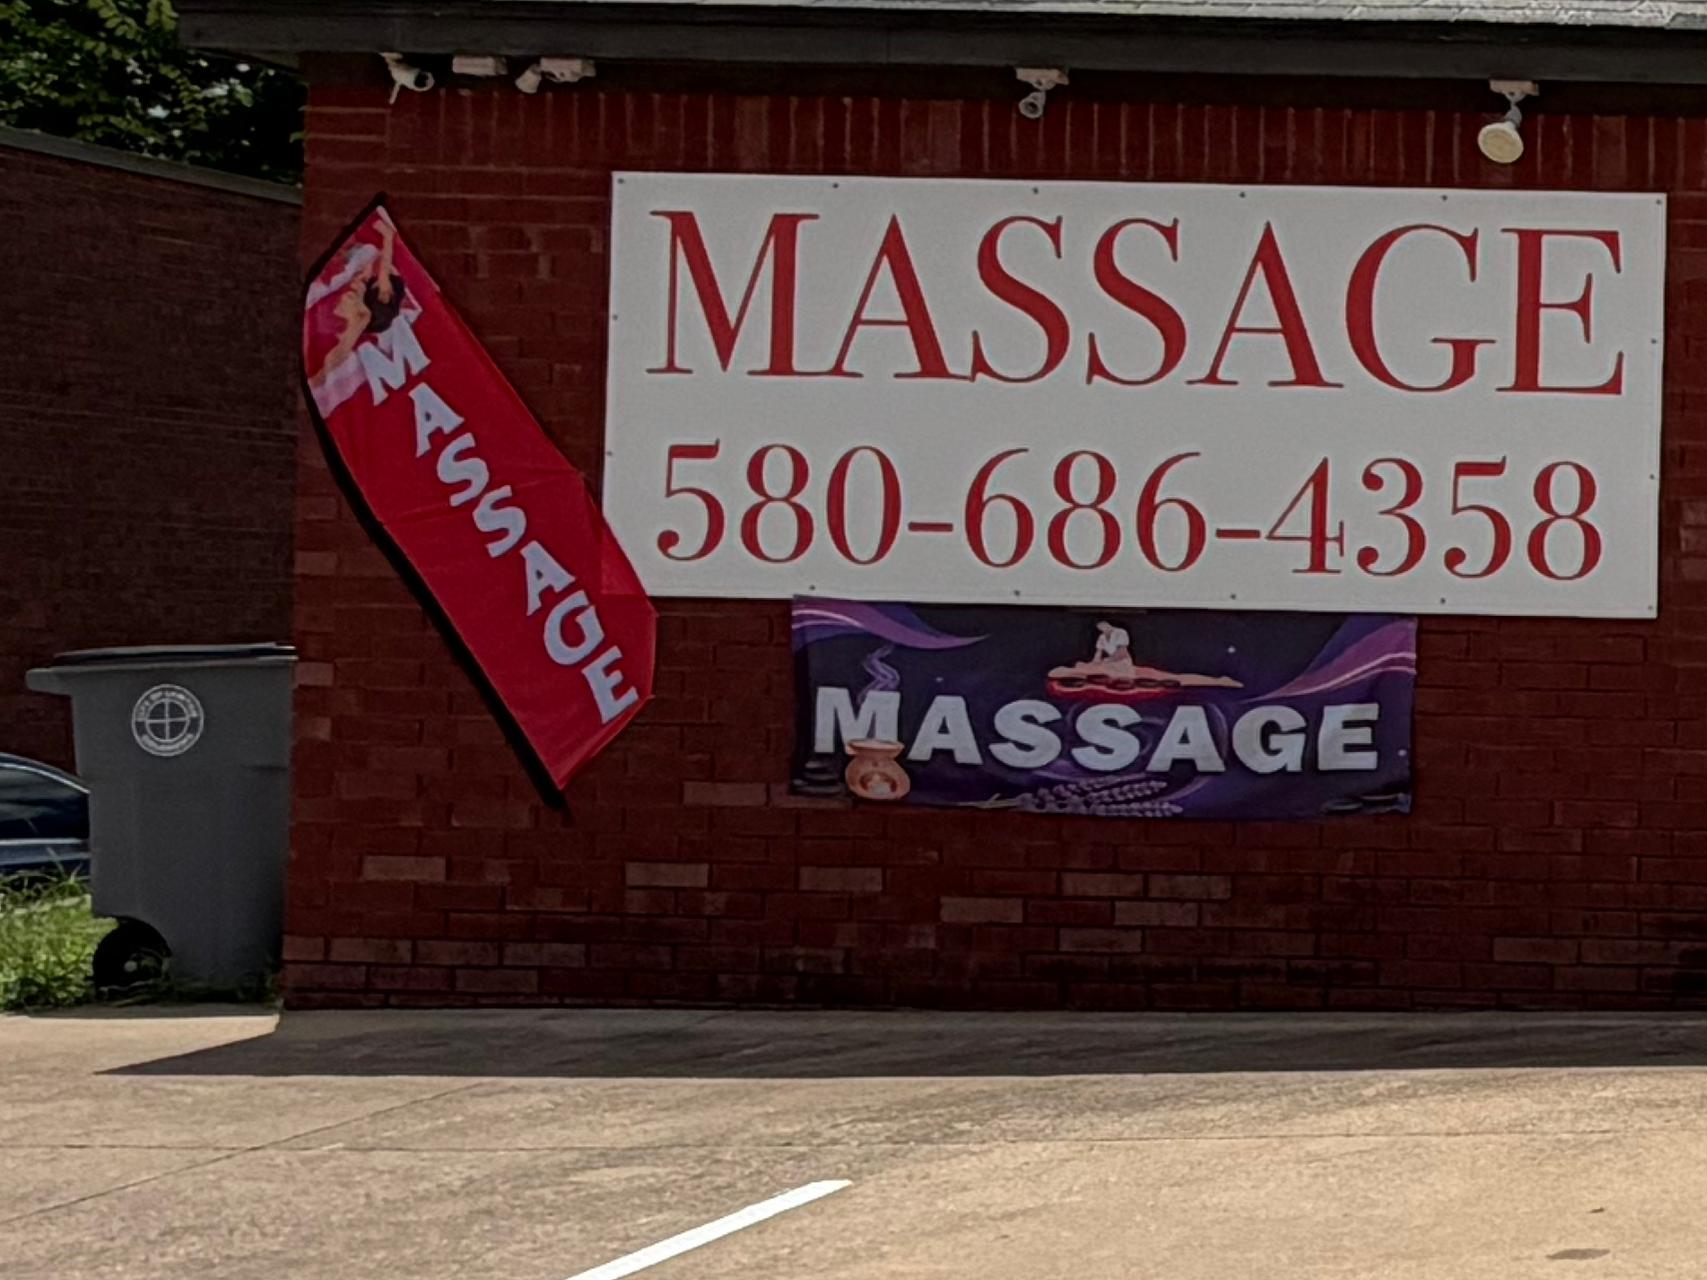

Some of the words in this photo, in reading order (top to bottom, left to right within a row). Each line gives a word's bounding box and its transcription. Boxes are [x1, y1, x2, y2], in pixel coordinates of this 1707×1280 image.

[646, 209, 1626, 396] MASSAGE
[357, 307, 640, 723] MASSAGE
[655, 437, 1604, 581] 580-686-4358
[814, 686, 1382, 775] MASSAGE
